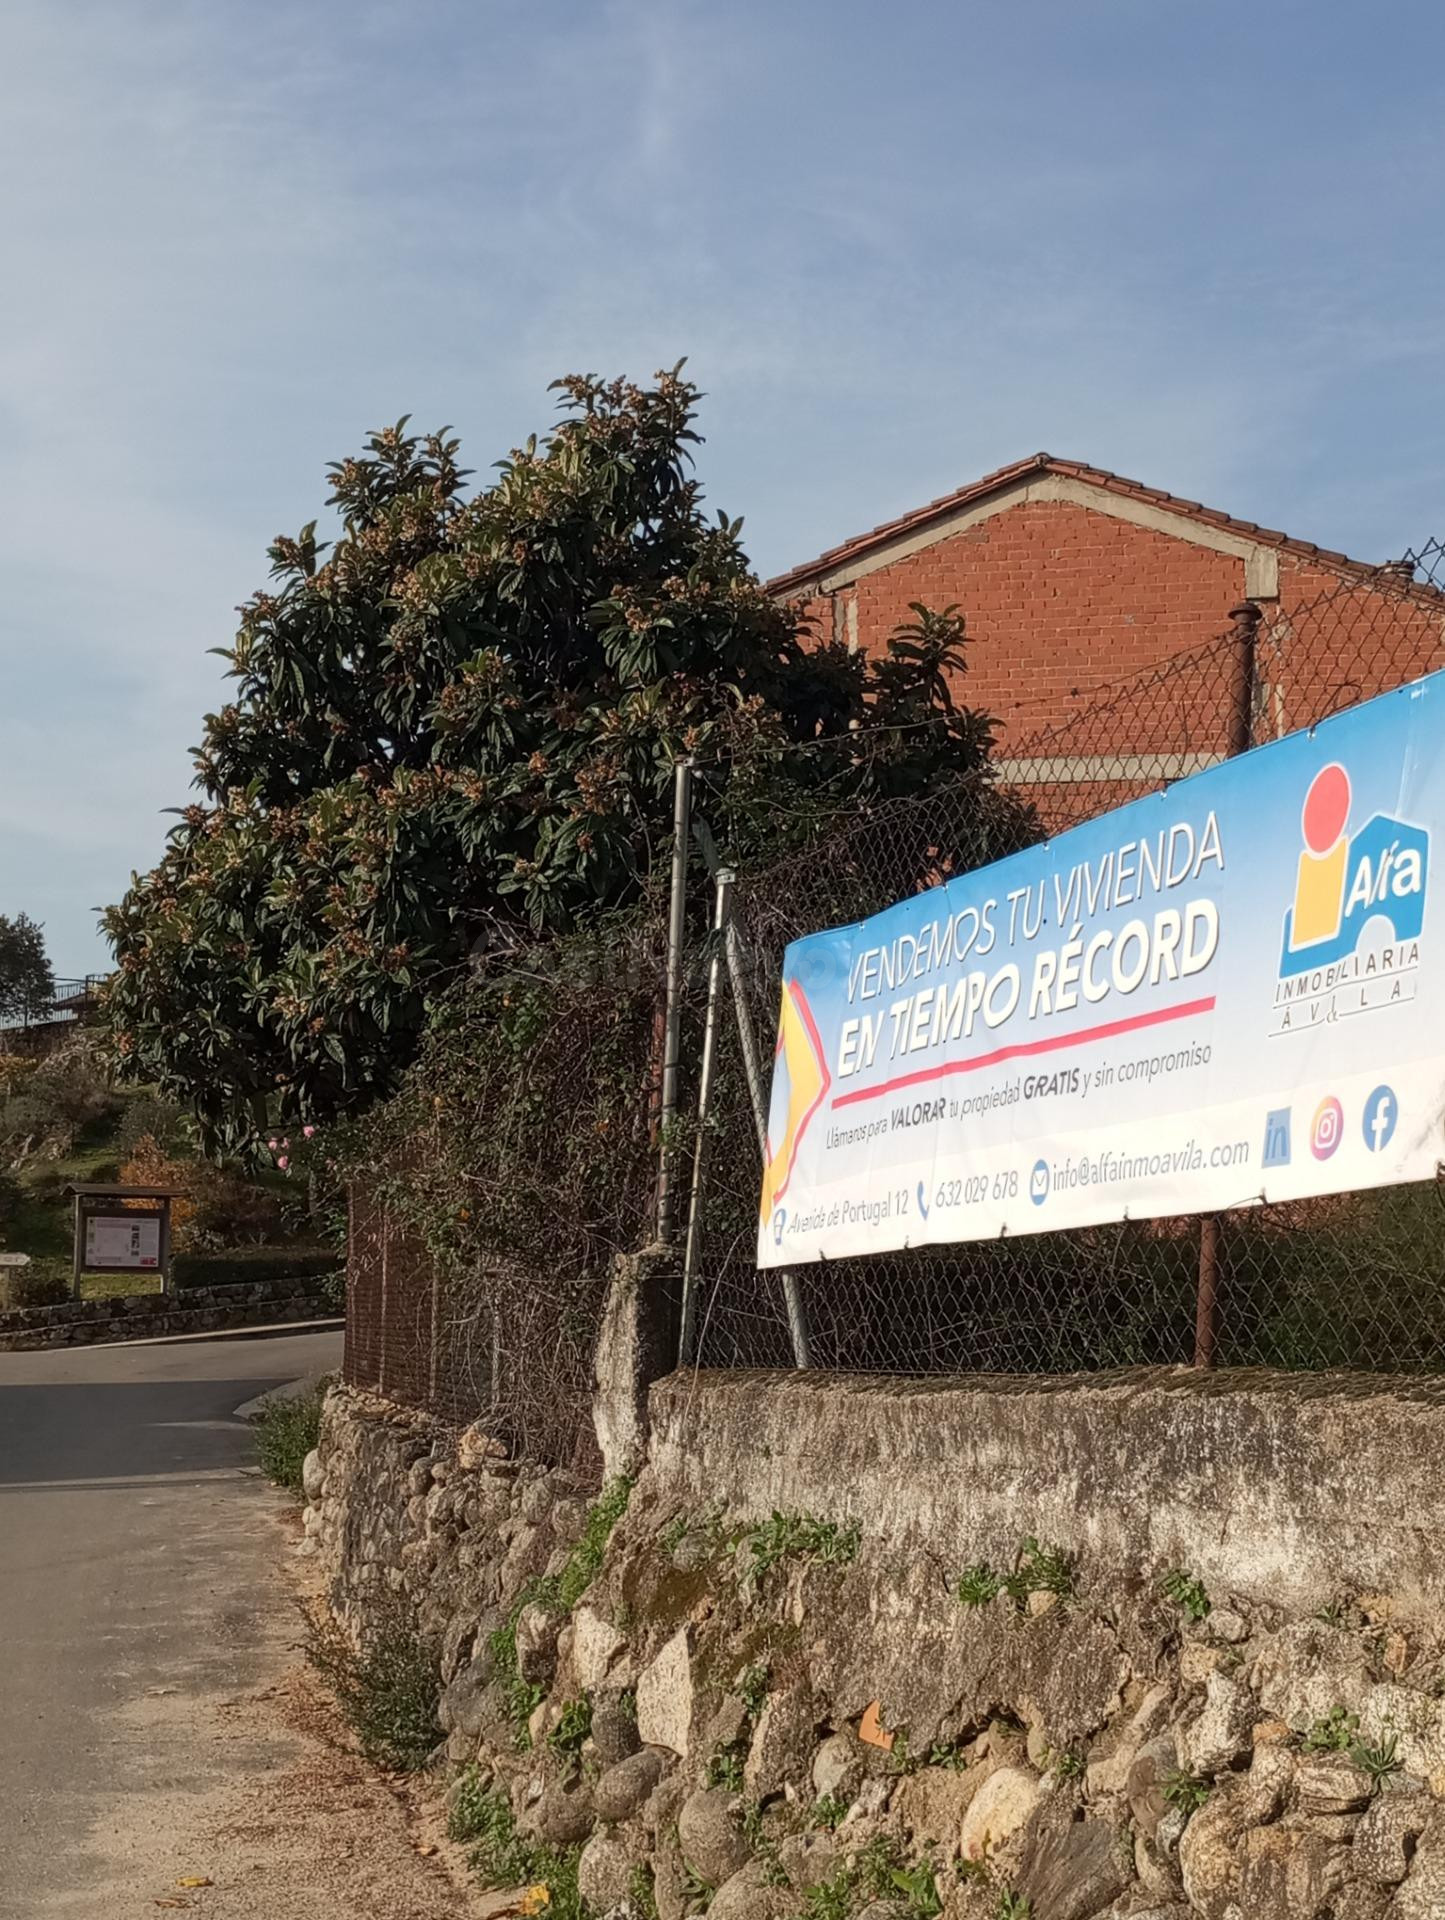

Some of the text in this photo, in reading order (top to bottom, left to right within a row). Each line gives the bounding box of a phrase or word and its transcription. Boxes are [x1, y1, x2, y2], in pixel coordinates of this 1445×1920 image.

[847, 899, 998, 1003] VENDEMOS
[1007, 880, 1046, 945] TU
[1054, 811, 1224, 927] VIVIENDA
[837, 898, 1219, 1079] EN TIEMPO RÉCORD
[1276, 943, 1419, 1002] INMOBILIARIA
[866, 1118, 888, 1144] para
[891, 1098, 946, 1131] VALORAR
[949, 1098, 959, 1119] tu
[960, 1077, 1021, 1121] propiedad
[1023, 1068, 1080, 1100] GRATIS
[1082, 1071, 1092, 1098] y
[1095, 1061, 1114, 1088] sin
[1118, 1041, 1212, 1083] compromiso
[936, 1170, 1019, 1208] 632 029 678
[1053, 1139, 1250, 1192] info@alfainmoavila.com
[827, 1202, 840, 1227] de
[841, 1191, 891, 1227] Portugal
[895, 1189, 909, 1216] 12
